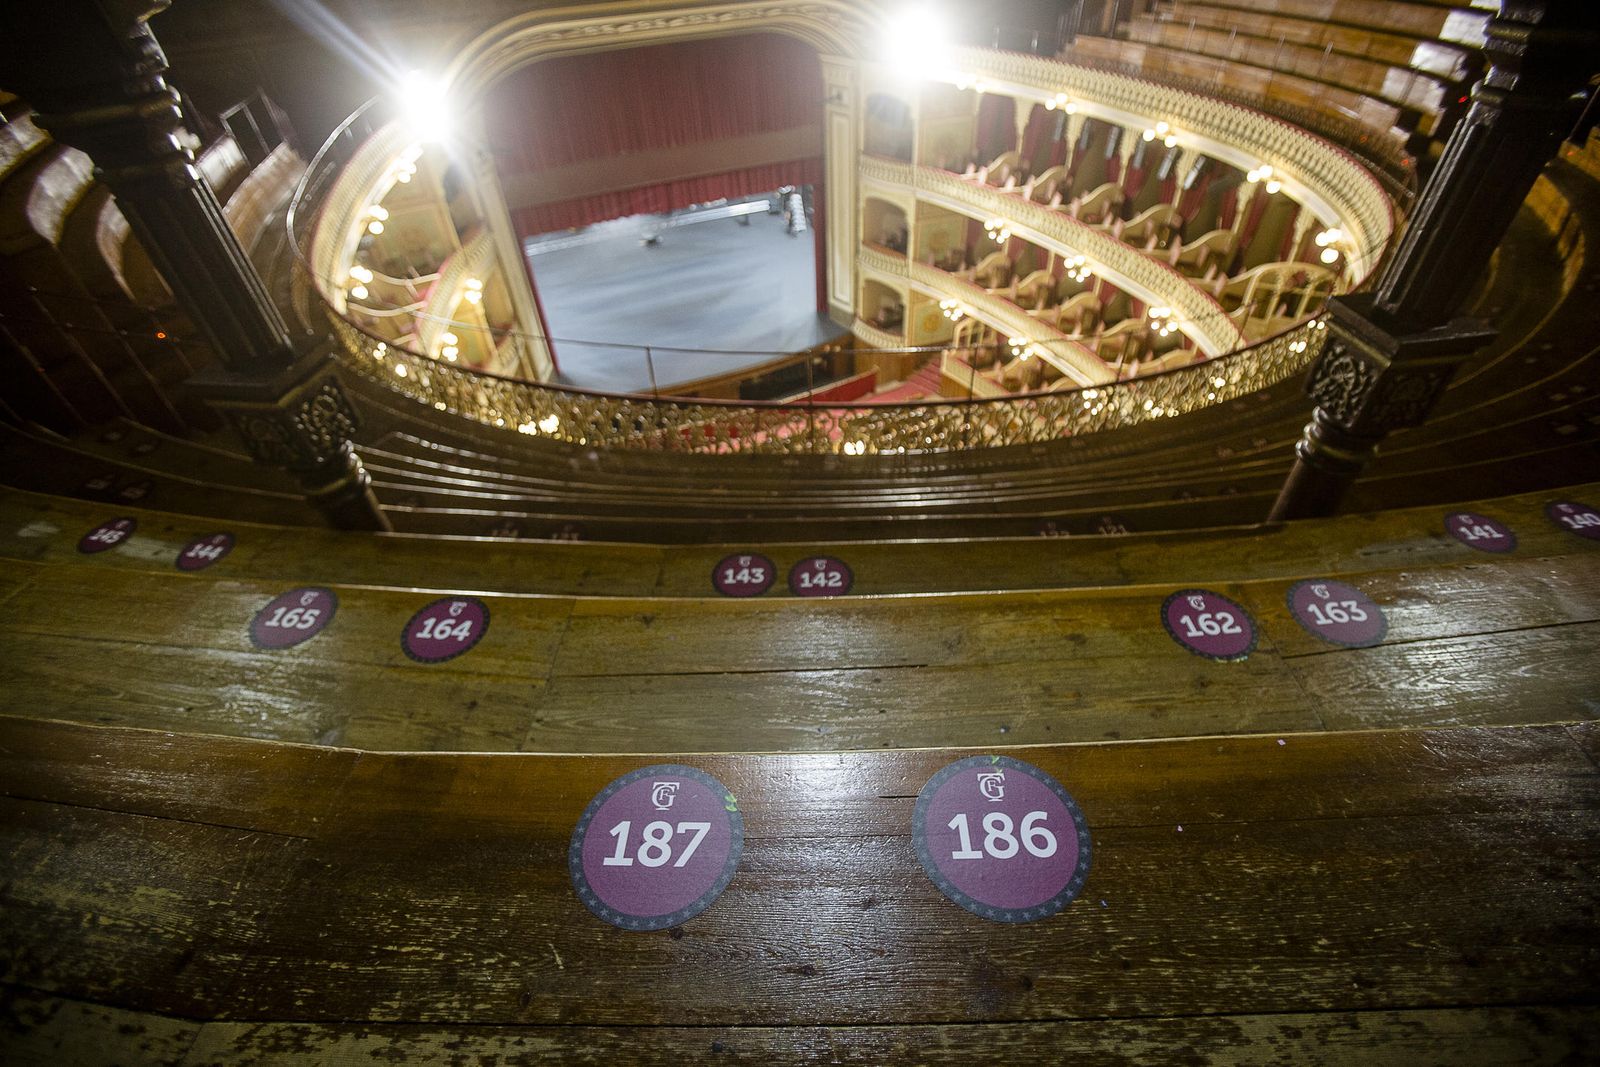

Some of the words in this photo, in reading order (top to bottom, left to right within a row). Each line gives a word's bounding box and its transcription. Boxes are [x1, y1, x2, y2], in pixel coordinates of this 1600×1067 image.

[1458, 525, 1504, 540] 141
[1561, 513, 1600, 529] 140
[186, 543, 224, 560] 144
[724, 568, 765, 584] 143
[800, 572, 842, 588] 142
[265, 606, 321, 629] 165
[1180, 612, 1242, 637] 162
[1307, 600, 1368, 626] 163
[416, 618, 473, 641] 164
[603, 820, 712, 868] 187
[948, 811, 1058, 860] 186
